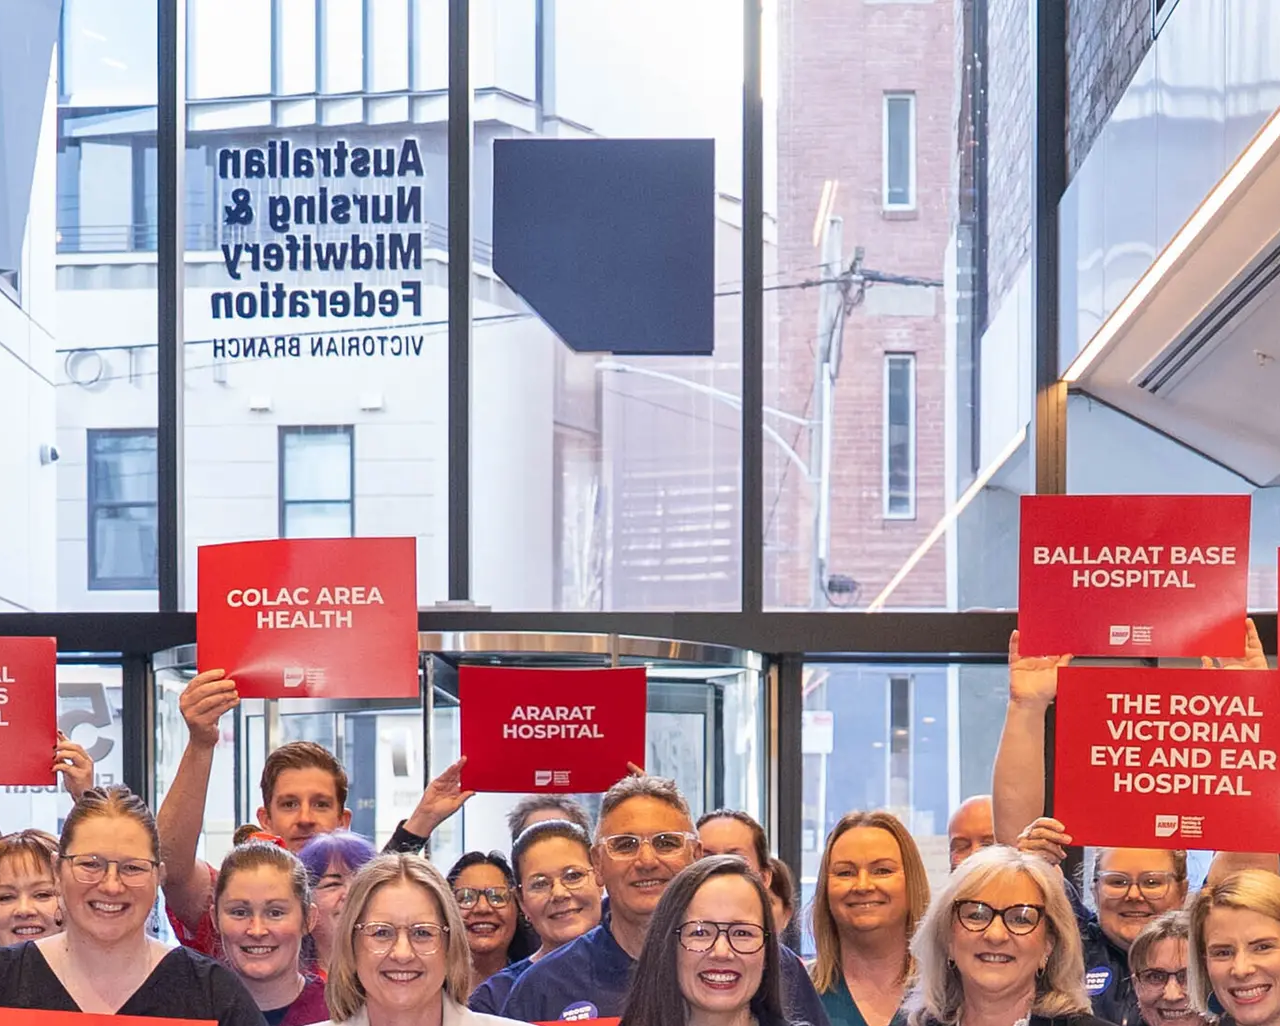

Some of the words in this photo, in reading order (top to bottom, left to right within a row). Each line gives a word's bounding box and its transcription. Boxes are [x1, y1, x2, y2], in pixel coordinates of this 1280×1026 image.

[1033, 546, 1164, 565] BALLARAT
[1170, 546, 1237, 565] BASE
[1072, 569, 1197, 589] HOSPITAL
[226, 586, 310, 608] COLAC
[315, 586, 385, 605] AREA
[257, 610, 353, 629] HEALTH
[510, 705, 596, 721] ARARAT
[1106, 693, 1161, 715] THE
[1169, 694, 1264, 717] ROYAL
[503, 723, 605, 740] HOSPITAL
[1106, 719, 1260, 744] VICTORIAN
[1090, 745, 1142, 767] EYE
[1147, 747, 1212, 769] AND
[1220, 748, 1277, 771] EAR
[1113, 772, 1252, 796] HOSPITAL
